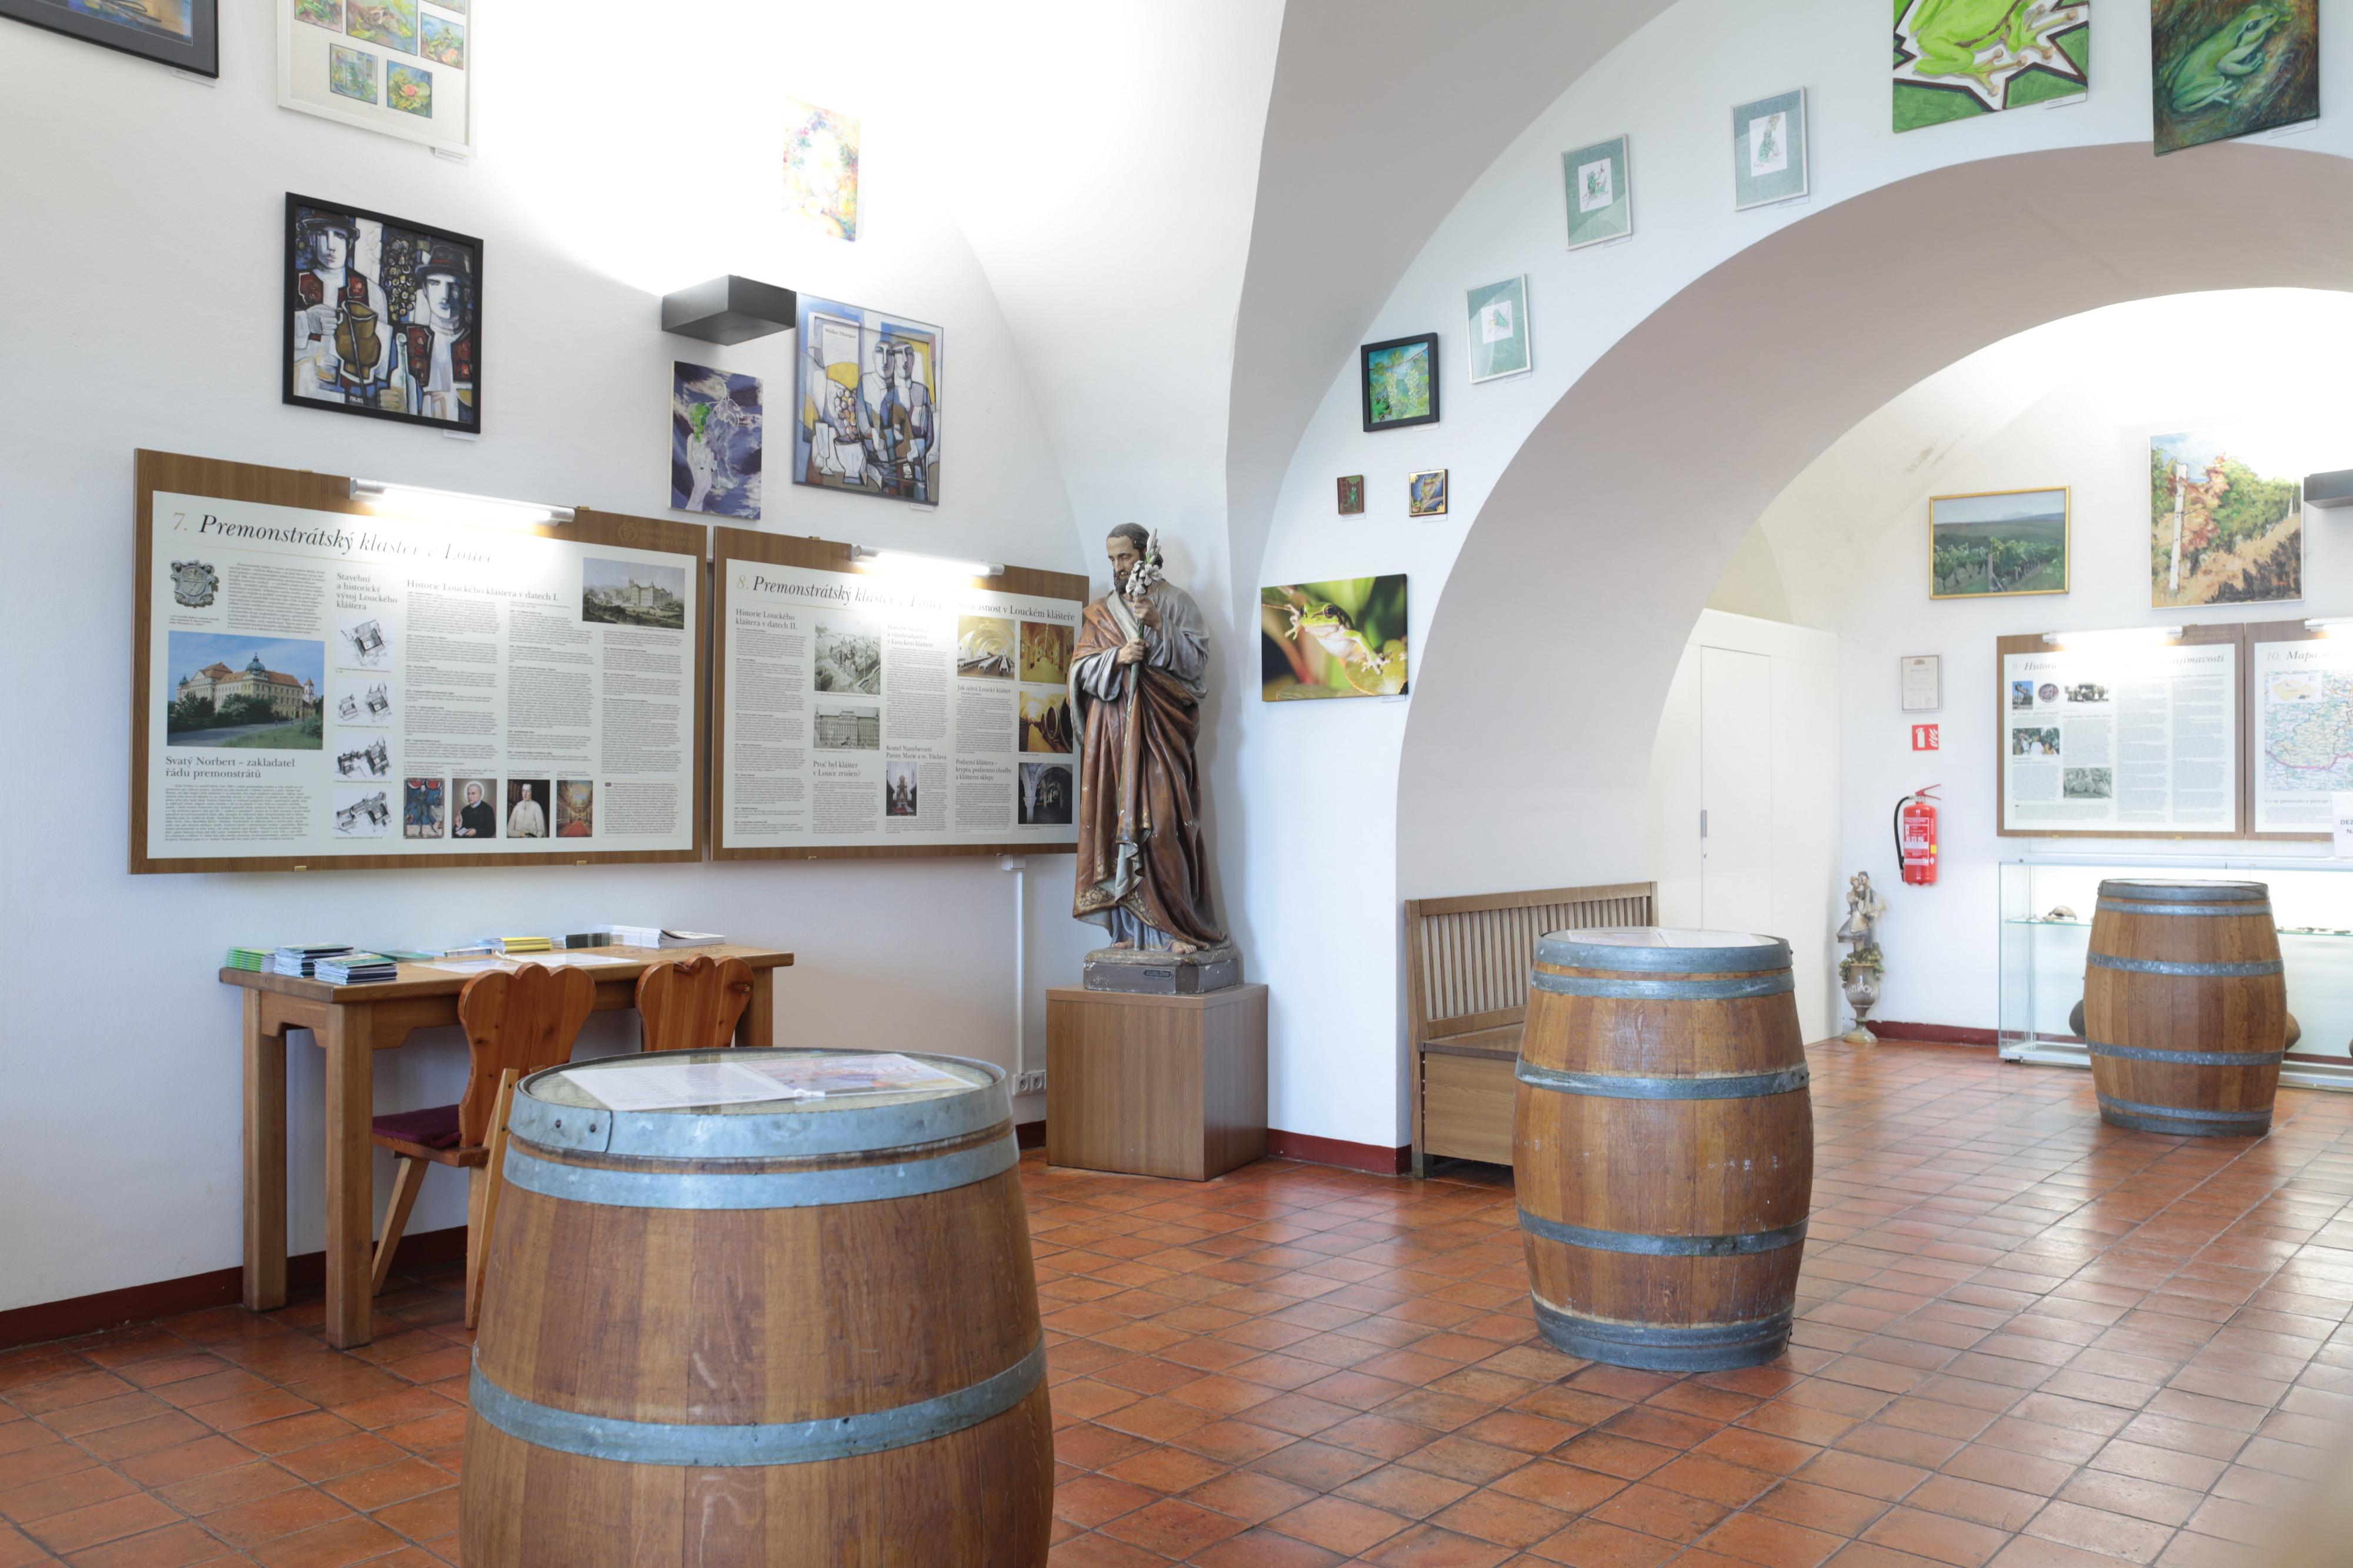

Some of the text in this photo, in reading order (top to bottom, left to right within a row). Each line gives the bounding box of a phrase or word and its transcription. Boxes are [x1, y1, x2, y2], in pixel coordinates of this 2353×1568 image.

[174, 512, 188, 531] 7.
[199, 515, 353, 555] Premonstrátský
[336, 573, 371, 583] Stavební
[344, 582, 381, 594] historický
[407, 579, 439, 590] Historie
[443, 582, 484, 595] Louckého
[525, 592, 551, 600] datech
[736, 575, 748, 590] 8.
[753, 576, 852, 606] Premonstrátský
[336, 592, 398, 603] vývoj Louckého
[336, 600, 367, 610] kláštera
[736, 609, 794, 620] Historie Louckého
[1010, 605, 1045, 618] Louckém
[1047, 609, 1075, 621] klášteře
[736, 618, 761, 626] kláštera
[767, 620, 788, 629] datech
[2286, 650, 2318, 662] Mapa
[165, 756, 193, 768] Svatý
[196, 757, 236, 766] Norbert
[246, 758, 295, 768] zakladatel
[165, 768, 261, 780] řádu premonstrátů
